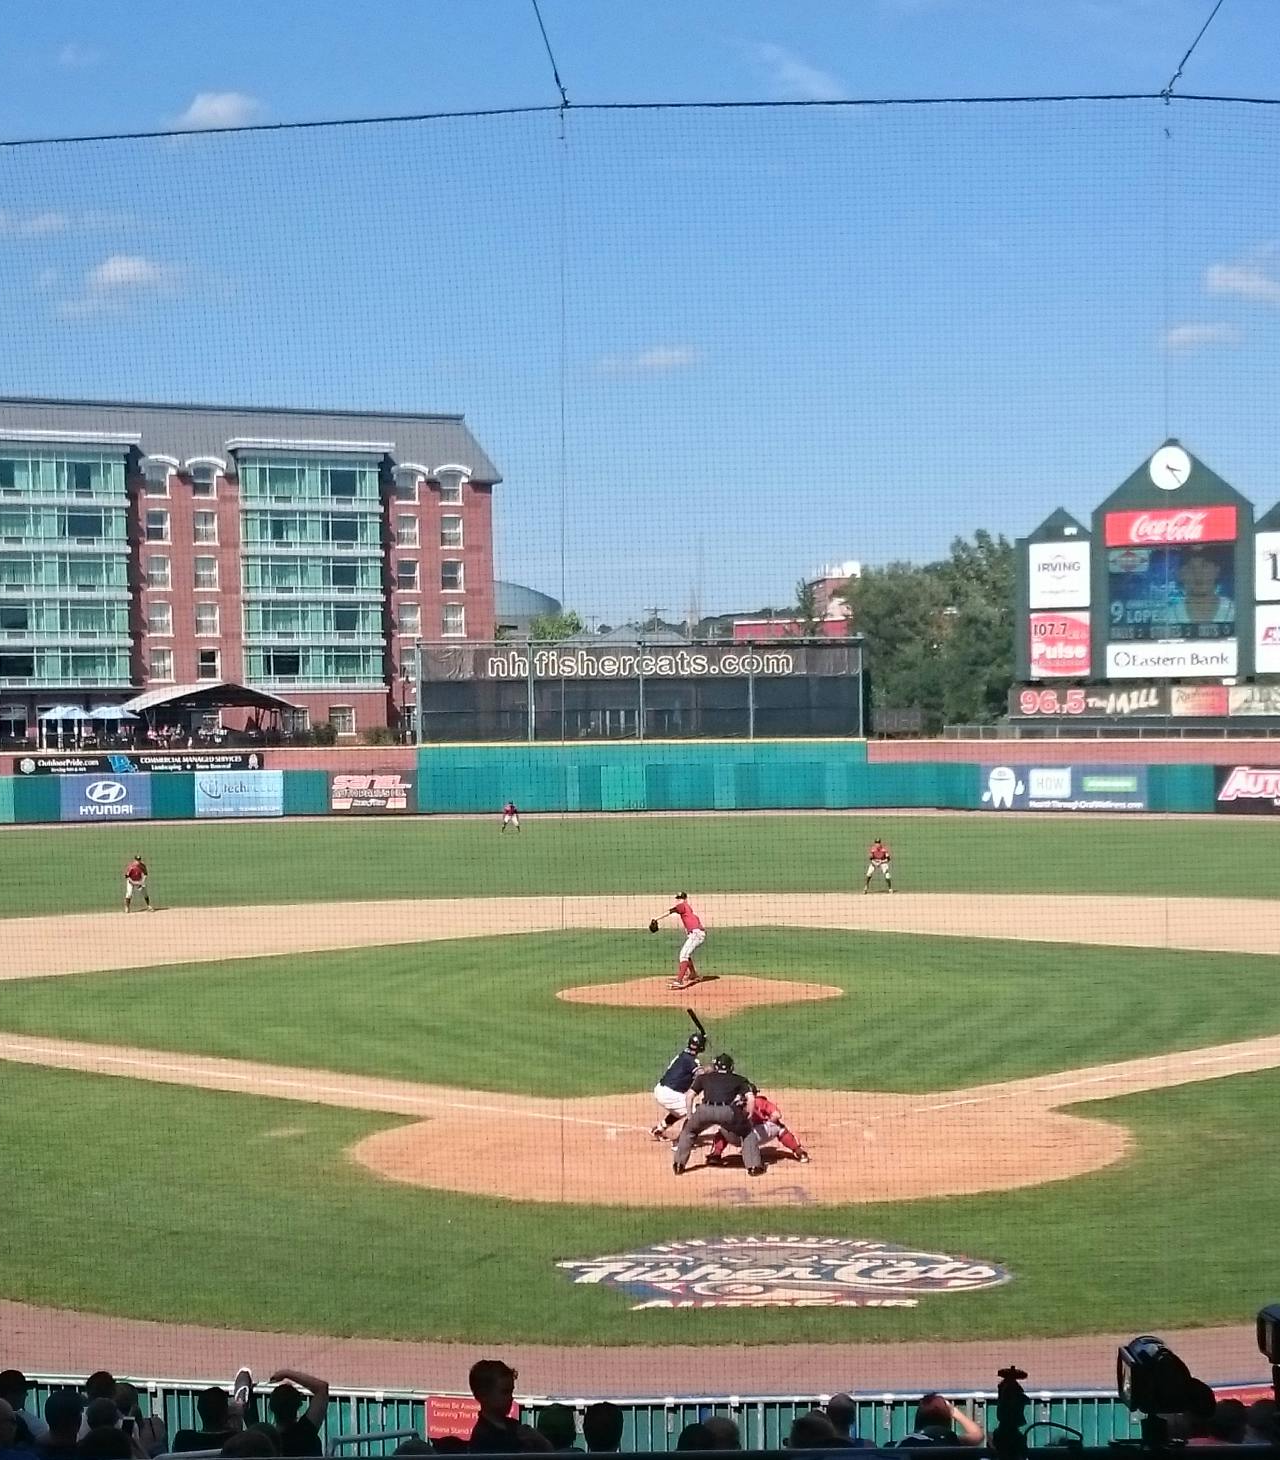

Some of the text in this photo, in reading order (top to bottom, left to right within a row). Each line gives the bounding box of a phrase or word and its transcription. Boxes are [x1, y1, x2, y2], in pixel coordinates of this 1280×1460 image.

[1038, 562, 1081, 572] IRVING
[1111, 603, 1124, 623] 9
[1033, 623, 1068, 636] 107.7
[1030, 642, 1088, 659] Pulse
[1132, 652, 1229, 667] Eastern Bank
[37, 758, 99, 767] OutdoorPride.com
[79, 805, 134, 815] HYUNDAI
[555, 1258, 998, 1284] Fisher Cats
[433, 1410, 458, 1419] Leaving
[450, 1426, 470, 1435] Stand
